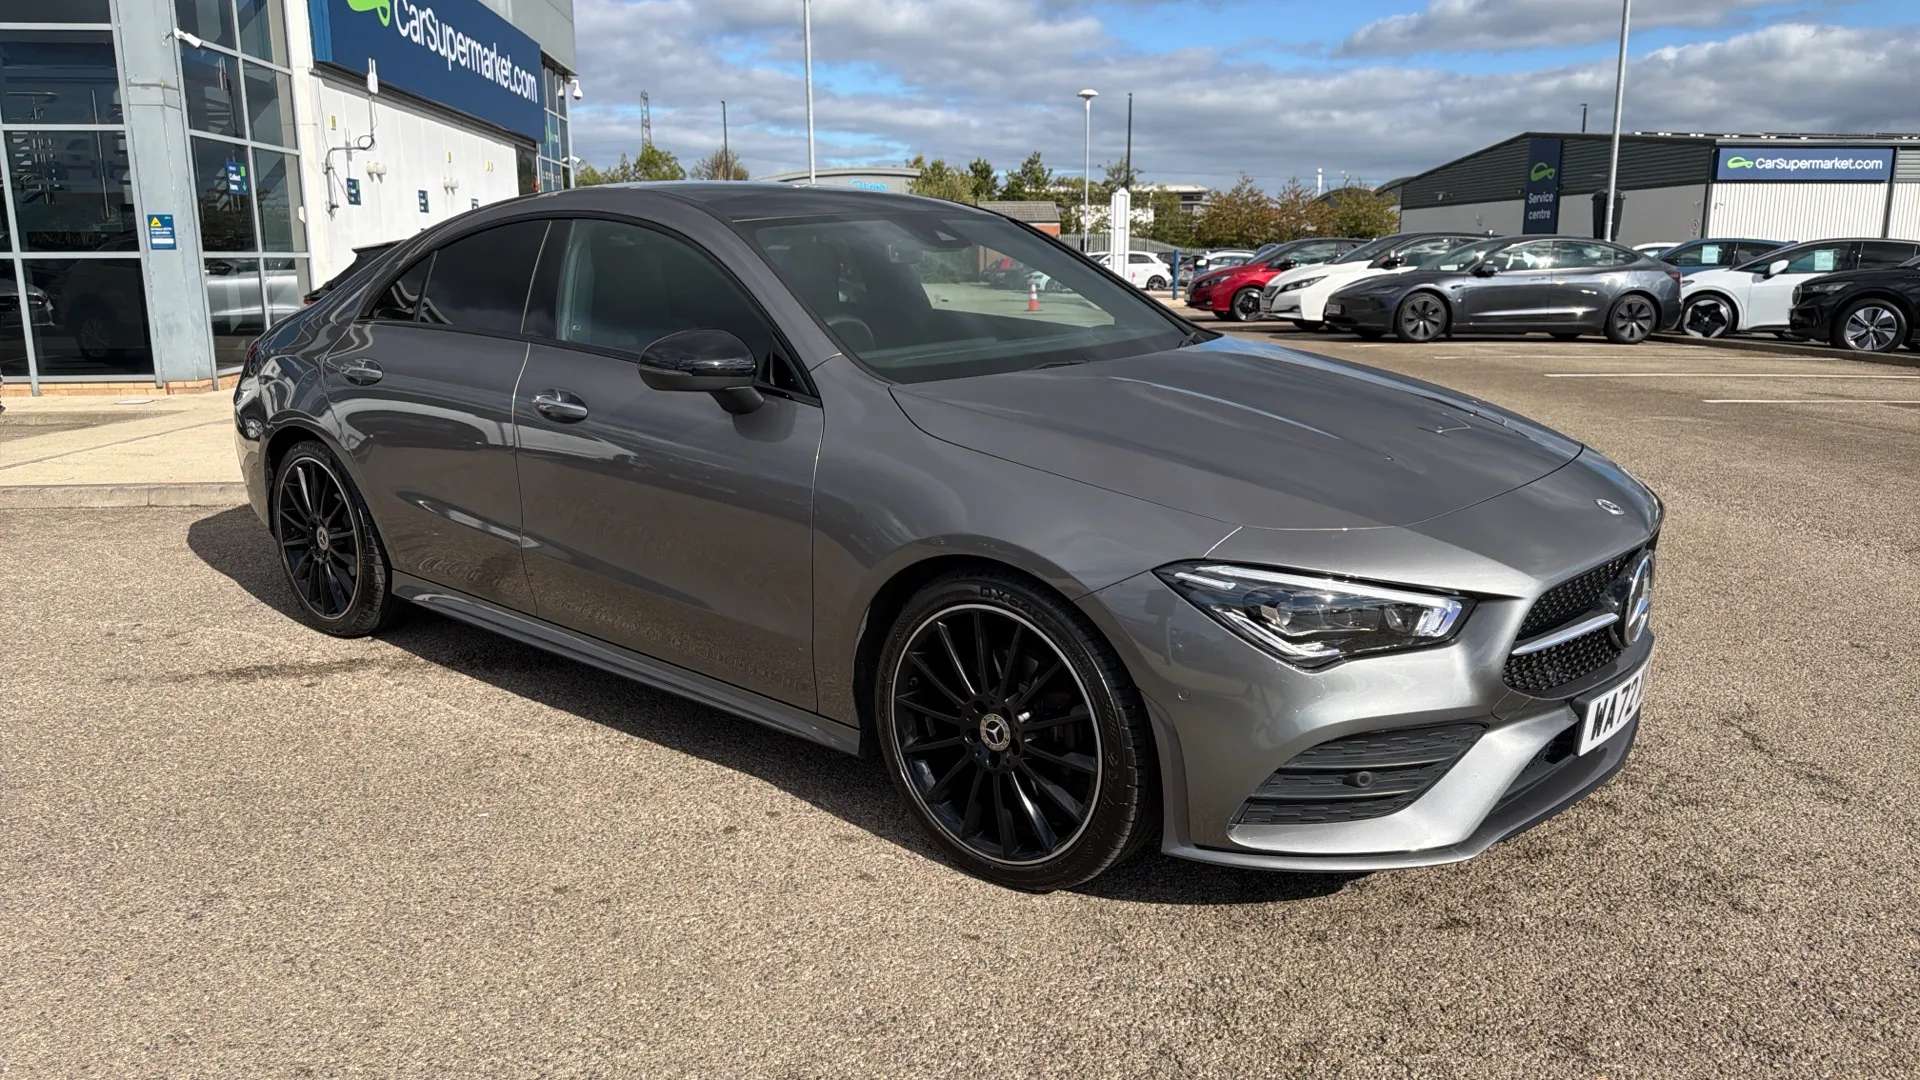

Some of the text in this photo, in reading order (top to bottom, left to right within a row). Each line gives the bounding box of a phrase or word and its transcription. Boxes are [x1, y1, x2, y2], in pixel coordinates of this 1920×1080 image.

[394, 0, 538, 103] CarSupermarket.com
[1755, 156, 1883, 171] CarSupermarket.com
[1528, 192, 1554, 204] Service
[1528, 209, 1551, 220] centre
